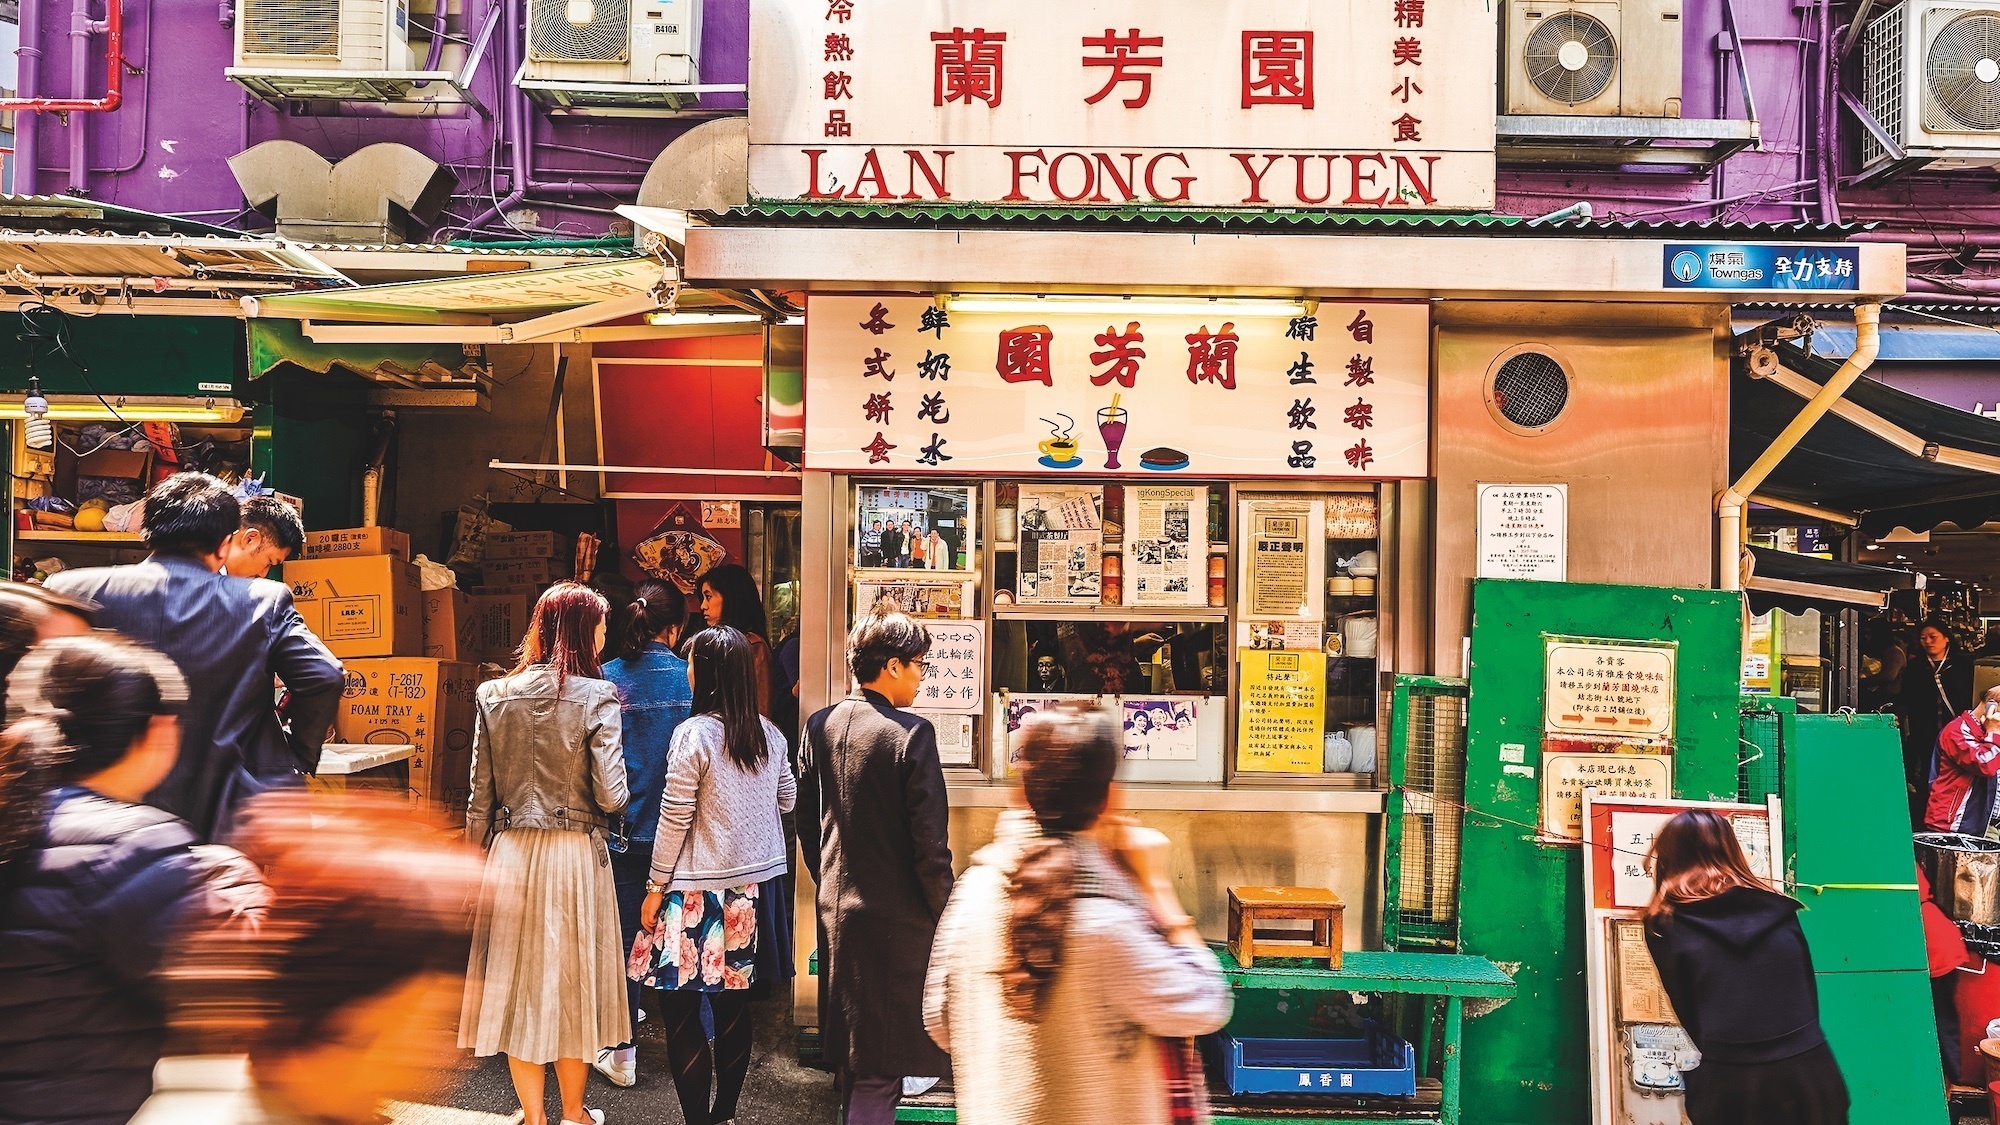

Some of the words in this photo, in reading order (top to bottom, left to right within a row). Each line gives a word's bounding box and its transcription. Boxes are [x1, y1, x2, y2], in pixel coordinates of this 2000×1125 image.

[655, 25, 678, 33] R410A
[823, 0, 855, 138] 冷熱飲品
[930, 28, 1314, 110] 蘭芳園
[1391, 0, 1425, 143] 精美小食
[801, 149, 955, 201] LAN
[1002, 148, 1198, 202] FONG
[1229, 151, 1442, 206] YUEN
[1708, 251, 1745, 266] 煤氣
[1708, 267, 1763, 282] Towngas
[1775, 256, 1853, 282] 全力支持
[859, 302, 897, 465] 各式餅食
[916, 305, 953, 466] 鮮奶汽水
[1285, 315, 1319, 469] 衛生飲品
[704, 508, 713, 523] 2
[1258, 541, 1304, 552] 嚴正聲明
[1596, 656, 1625, 666] 各貴客
[344, 672, 367, 687] ulead
[390, 673, 423, 686] T-2617
[388, 686, 426, 699] (T-132)
[915, 685, 974, 699] 謝合作
[351, 704, 379, 715] FOAM
[386, 705, 412, 716] TRAY
[1577, 764, 1637, 775] 本店現已休息
